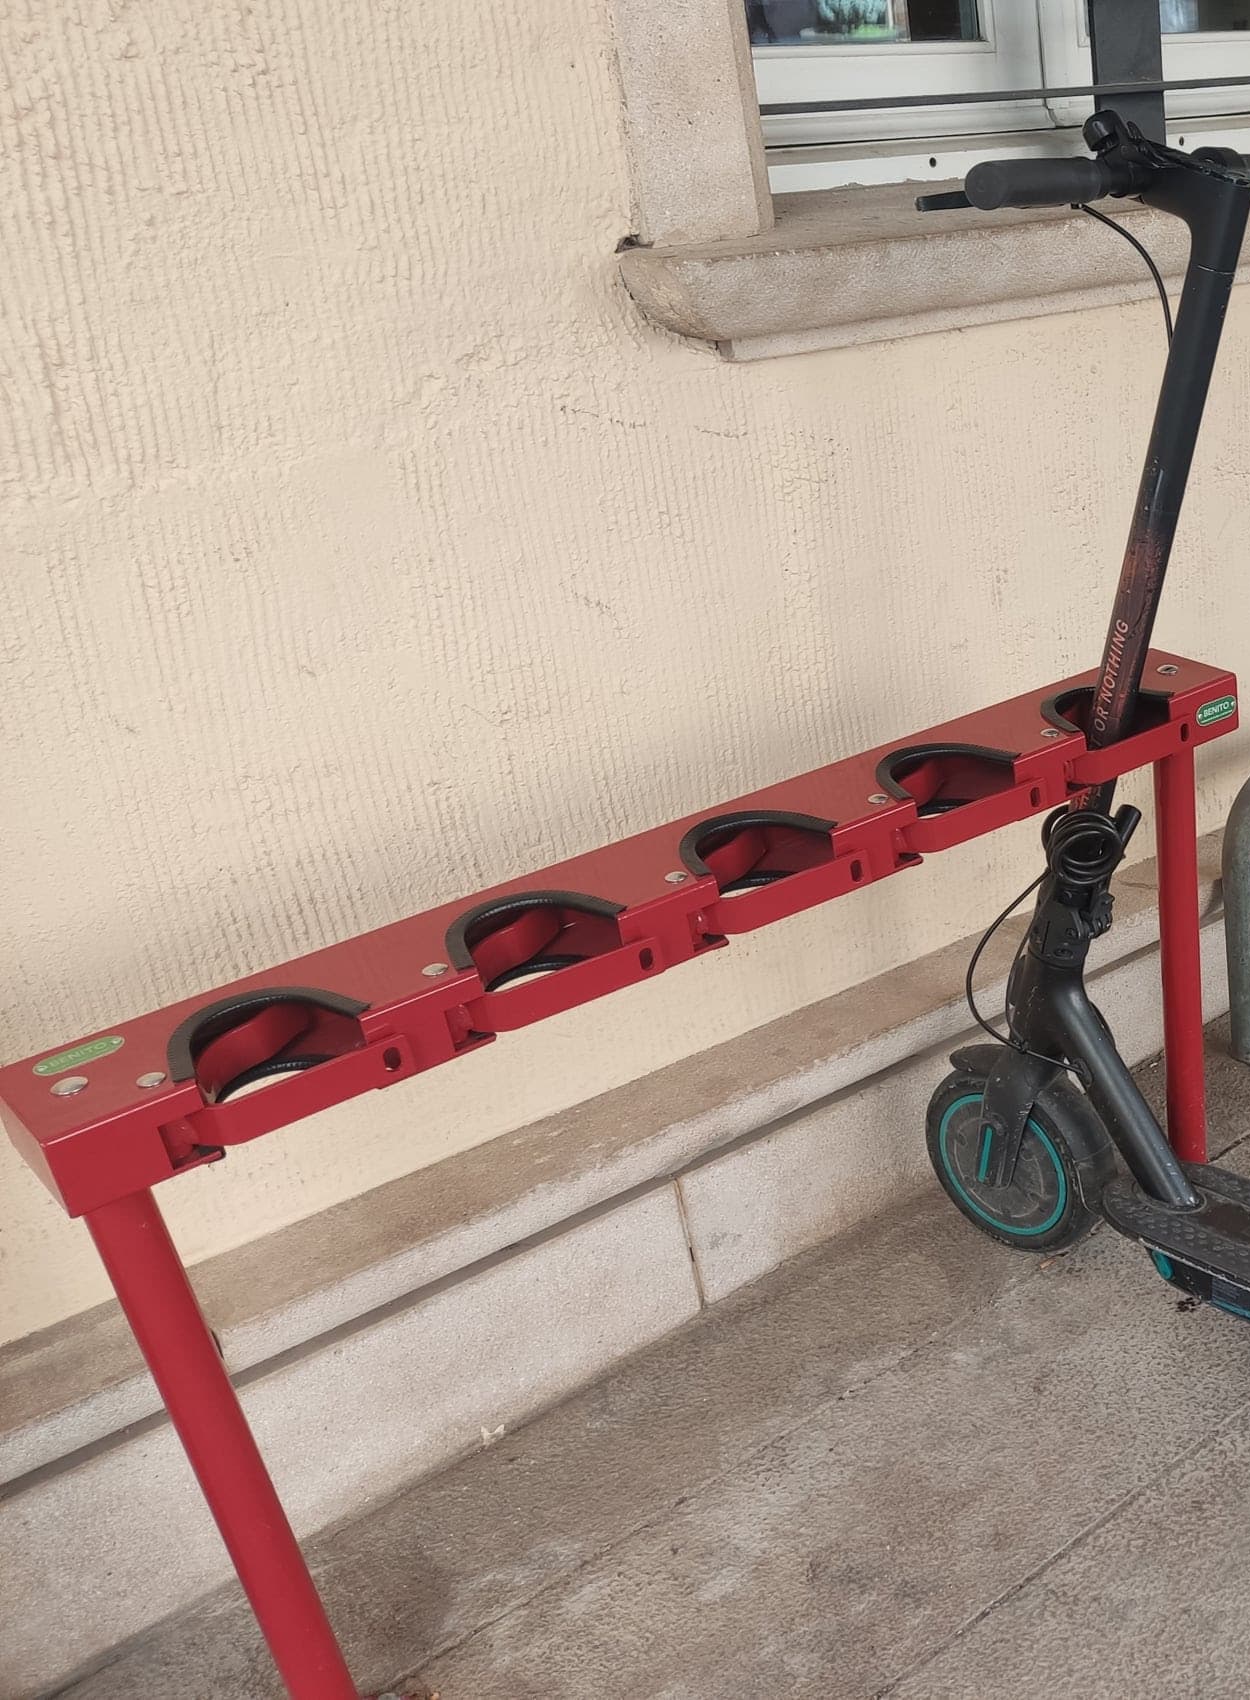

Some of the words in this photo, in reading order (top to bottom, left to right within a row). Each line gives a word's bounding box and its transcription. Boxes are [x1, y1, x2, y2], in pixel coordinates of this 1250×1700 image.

[1101, 619, 1129, 704] NOTHING
[1094, 706, 1110, 731] OR
[1203, 701, 1230, 718] BENITO
[49, 1041, 107, 1068] BENITO
